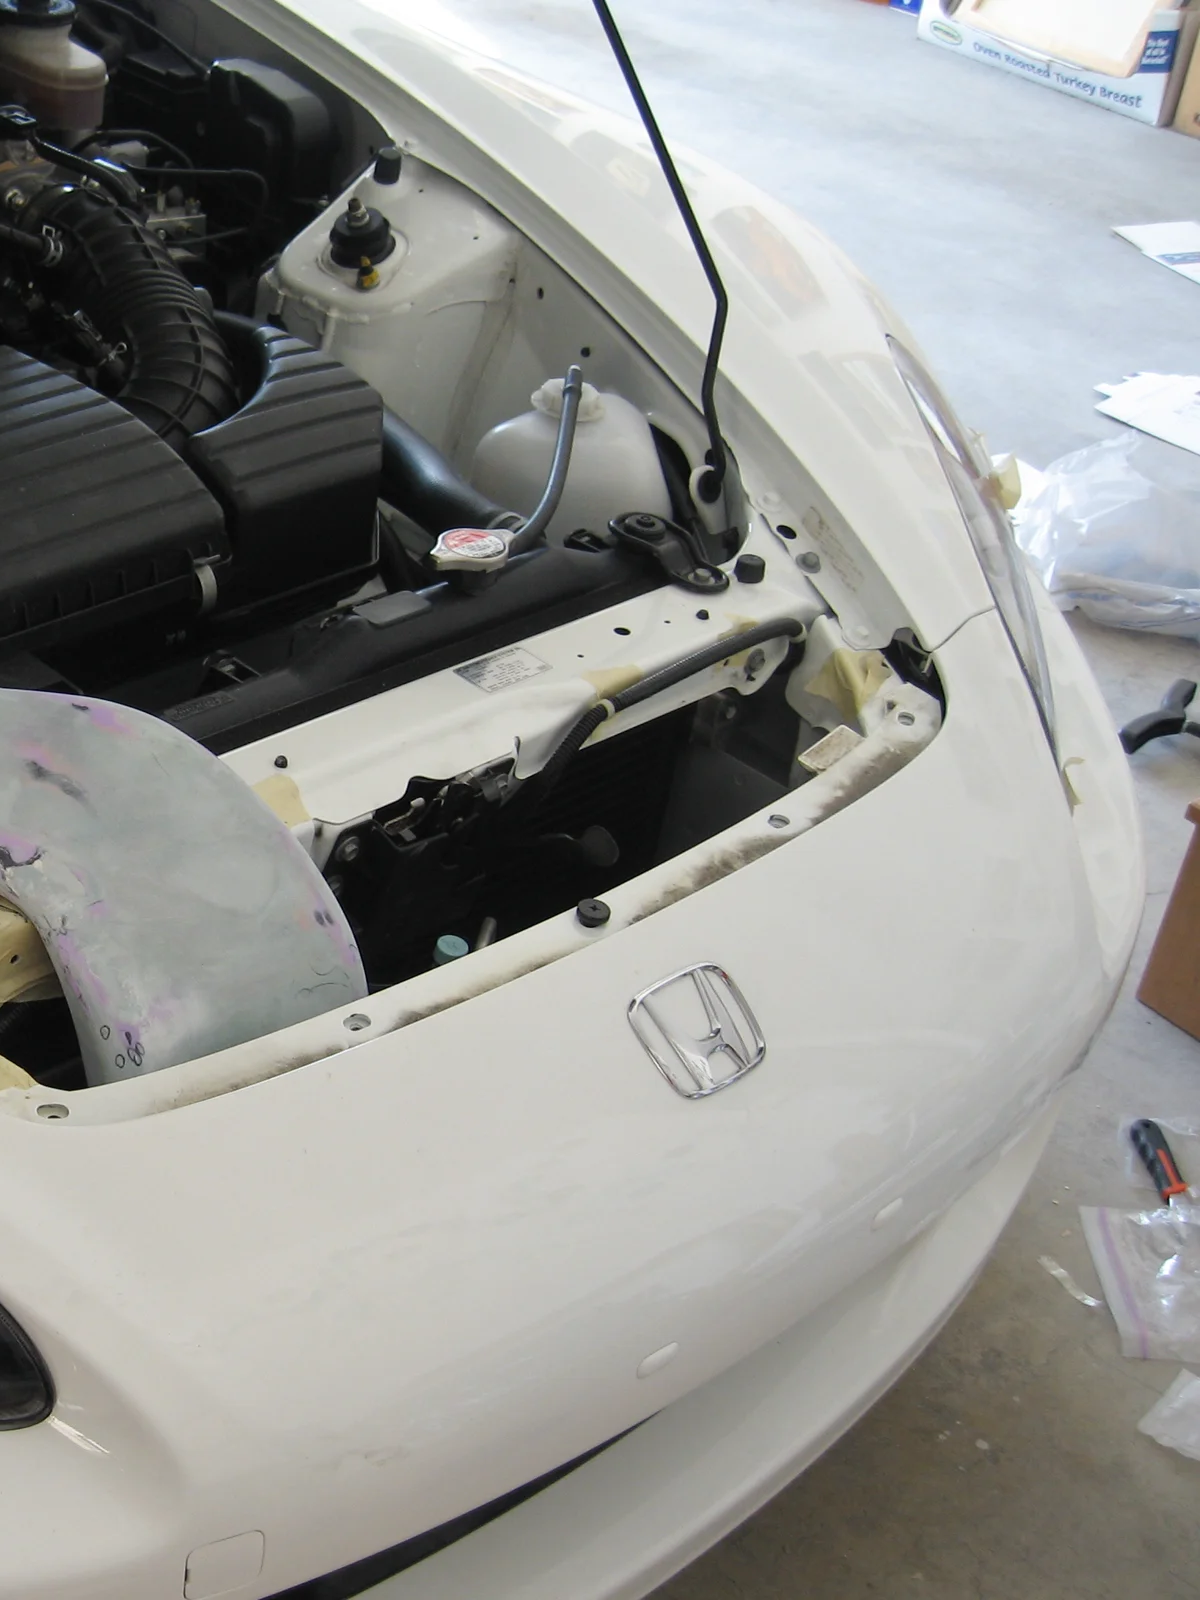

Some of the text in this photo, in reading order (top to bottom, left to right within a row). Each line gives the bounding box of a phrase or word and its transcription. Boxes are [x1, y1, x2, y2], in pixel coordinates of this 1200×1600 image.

[973, 41, 1143, 108] Oven Roasted Turkey Breast
